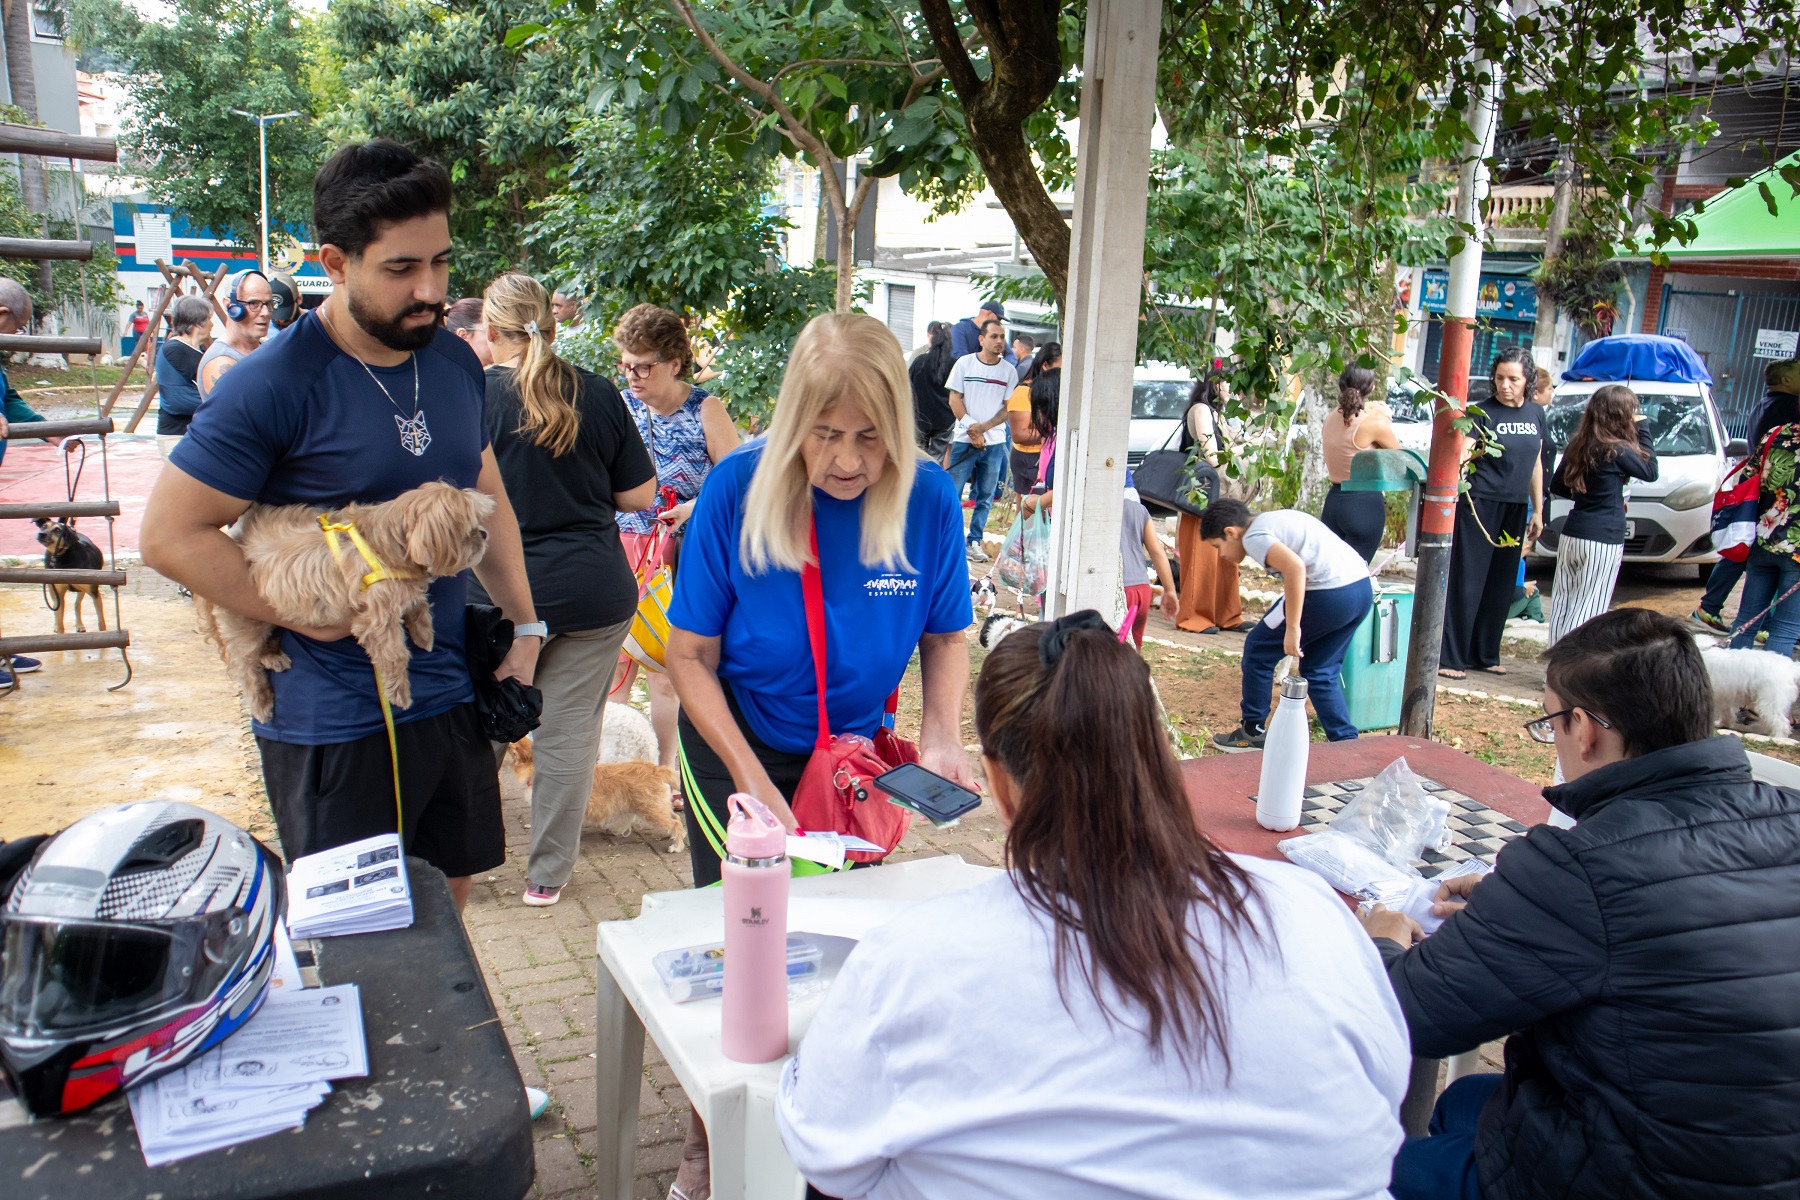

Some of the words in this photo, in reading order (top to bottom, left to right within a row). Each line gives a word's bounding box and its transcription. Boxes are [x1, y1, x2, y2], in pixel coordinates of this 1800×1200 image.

[1477, 299, 1501, 311] ULIMP
[1760, 341, 1782, 349] VENDE
[1496, 422, 1537, 435] GUESS
